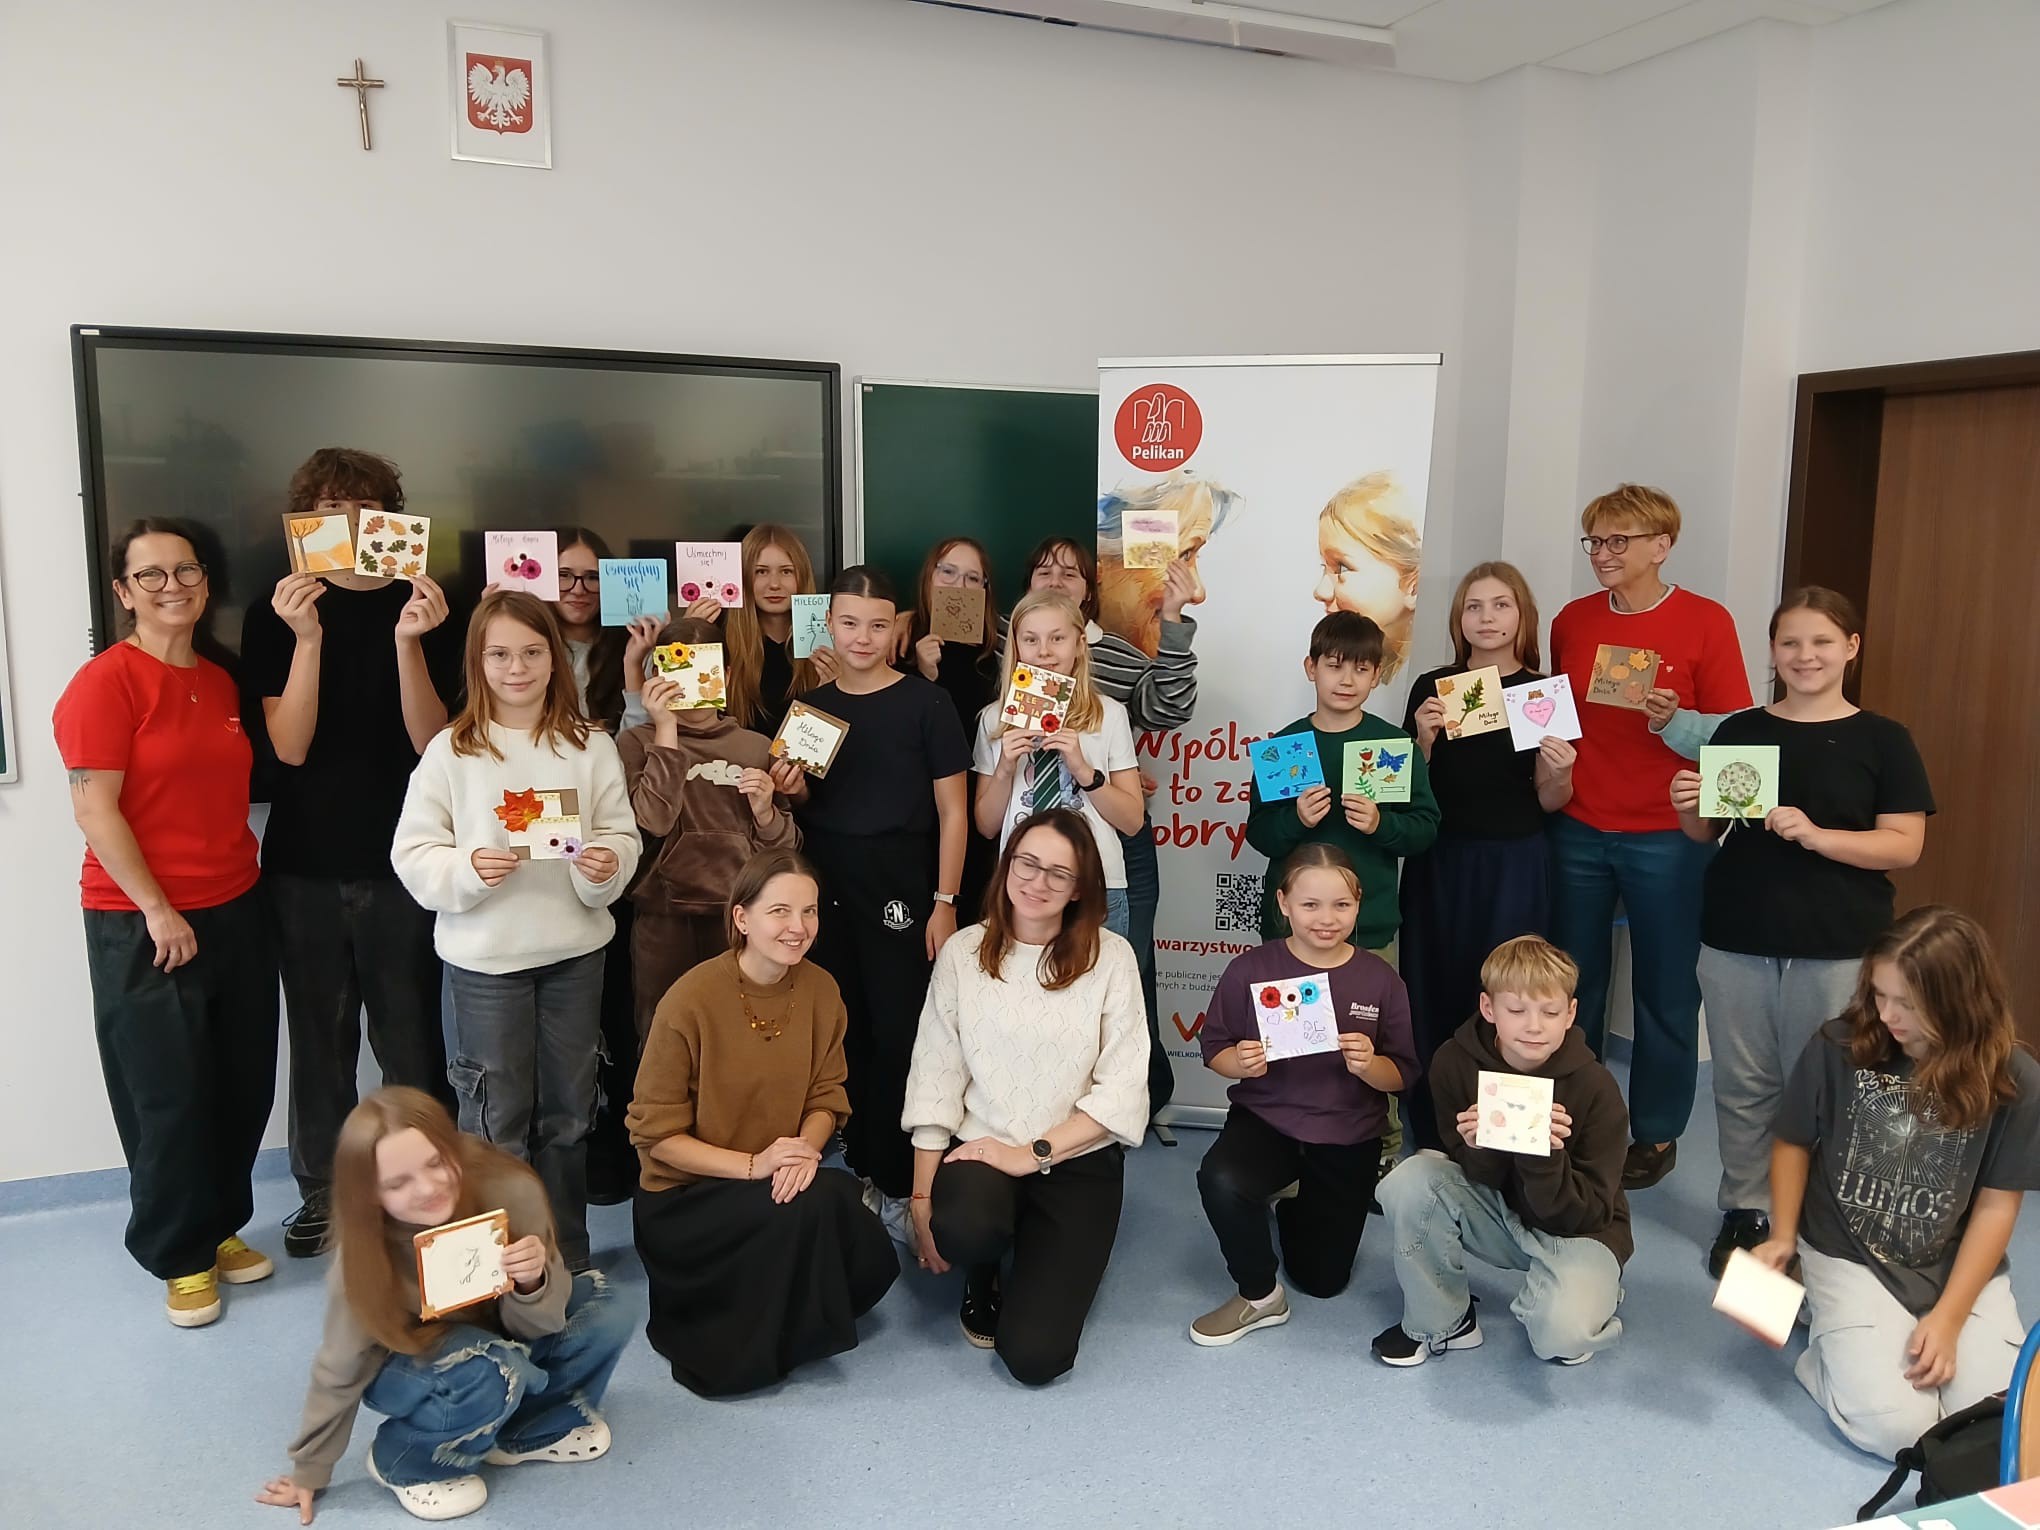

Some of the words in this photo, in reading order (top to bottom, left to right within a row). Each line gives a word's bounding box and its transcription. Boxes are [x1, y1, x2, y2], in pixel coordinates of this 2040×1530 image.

[1132, 445, 1184, 459] Pelikan
[1169, 773, 1202, 805] to
[1214, 782, 1251, 803] za
[1152, 813, 1247, 860] obry
[1153, 939, 1254, 956] warzystwo
[1165, 970, 1207, 981] publiczne
[1209, 973, 1221, 982] jes
[1156, 981, 1179, 991] nych
[1189, 982, 1216, 991] budże
[1167, 1050, 1204, 1059] WIELKOPO
